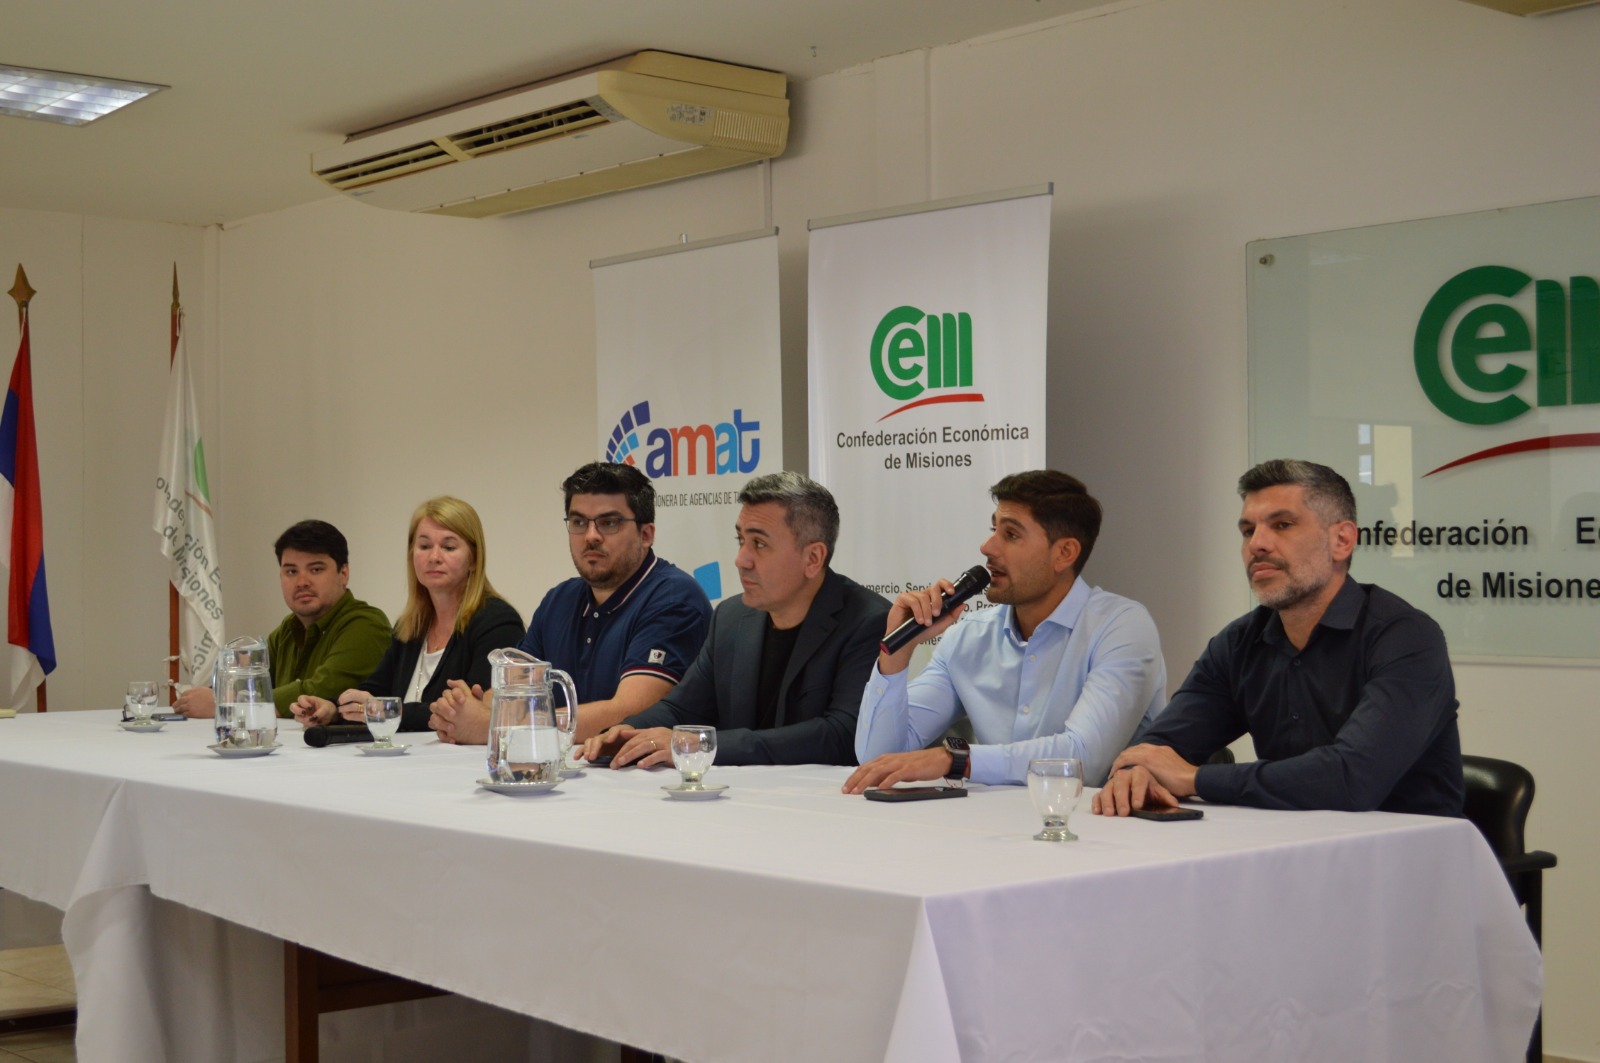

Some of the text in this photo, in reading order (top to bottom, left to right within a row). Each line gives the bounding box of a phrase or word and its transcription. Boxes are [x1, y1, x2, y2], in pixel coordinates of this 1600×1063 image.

[645, 408, 760, 478] amat
[836, 423, 1029, 448] Confederación Económica
[884, 451, 972, 469] de Misiones
[655, 494, 678, 507] IONERA
[680, 493, 688, 506] DE
[689, 491, 722, 506] AGENCIAS
[724, 491, 732, 505] DE
[1356, 518, 1528, 546] nfederación
[1437, 571, 1600, 598] de Misione
